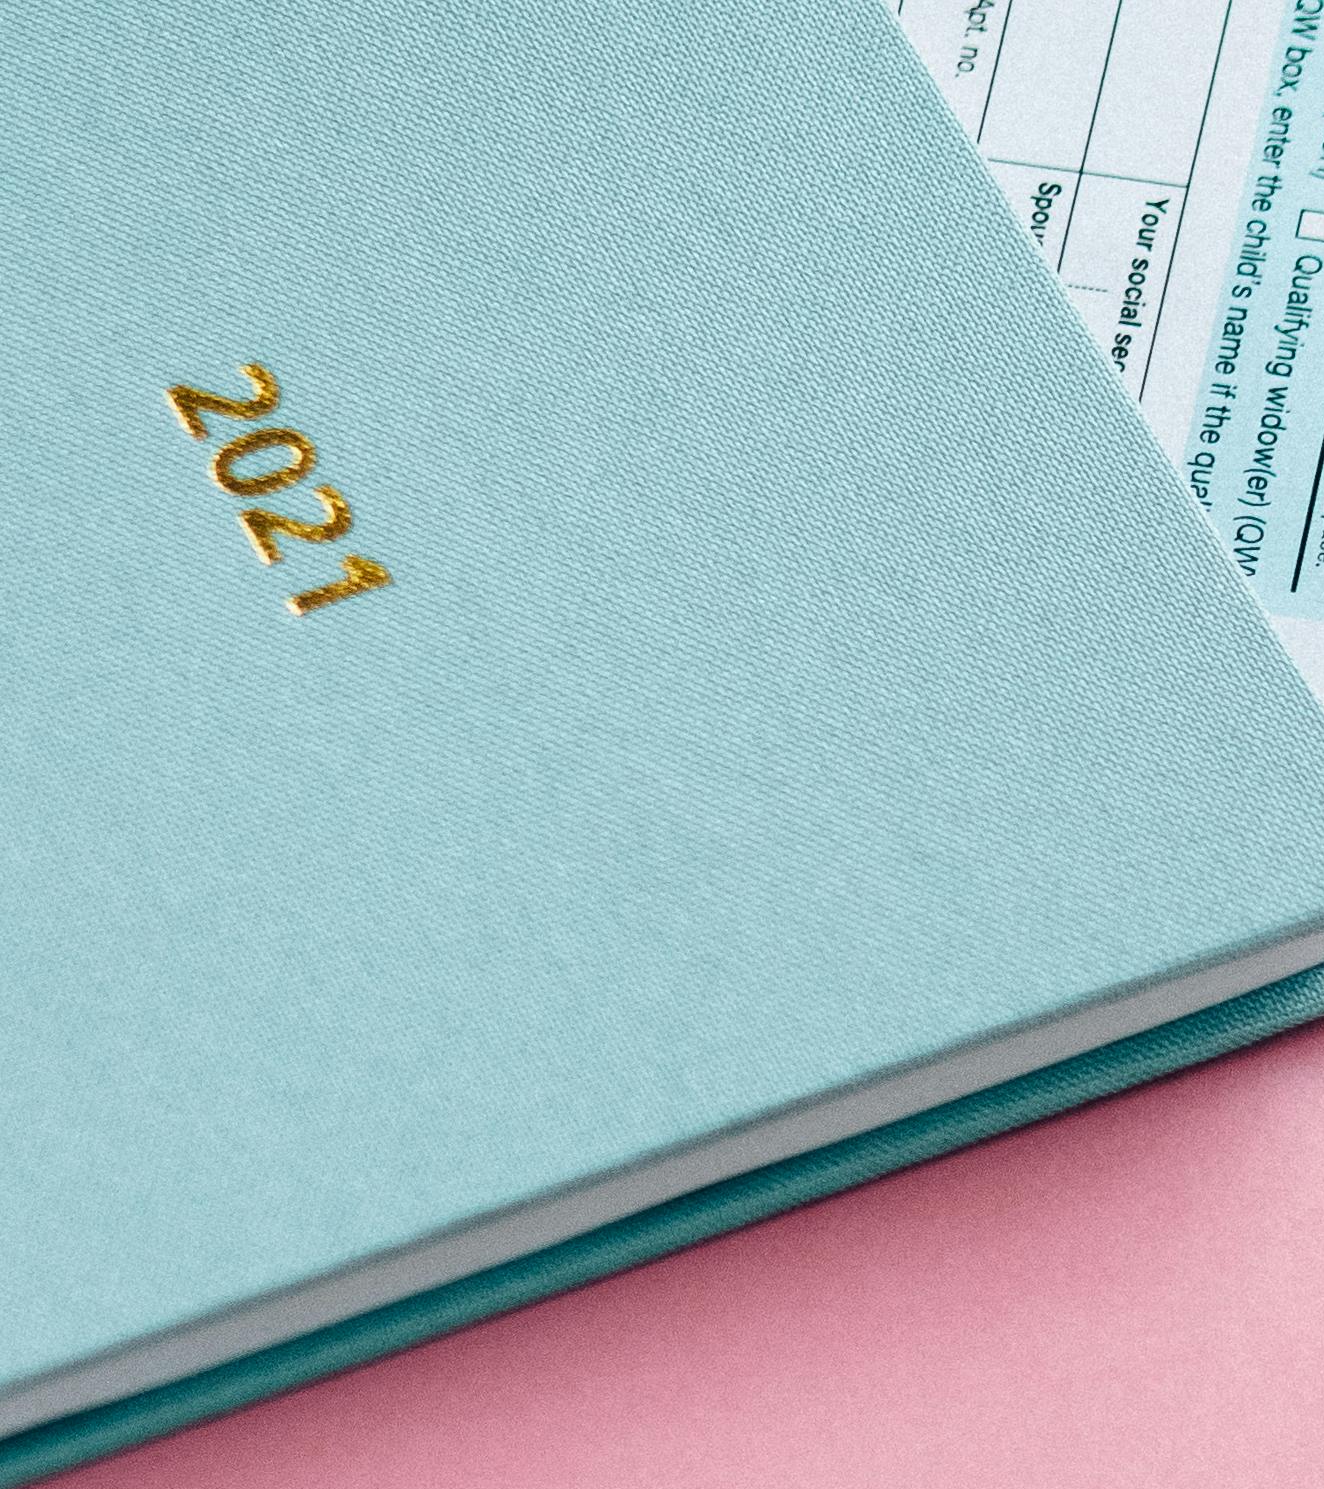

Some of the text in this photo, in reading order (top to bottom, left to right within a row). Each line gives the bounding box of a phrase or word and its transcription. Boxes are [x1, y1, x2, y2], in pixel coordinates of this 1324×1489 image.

[954, 0, 995, 78] Apt. no.
[1291, 0, 1323, 41] QW
[1272, 46, 1314, 97] box,
[1262, 105, 1293, 169] enter
[1030, 182, 1063, 247] Spou
[1136, 199, 1170, 252] Your
[1251, 175, 1283, 212] the
[1118, 258, 1150, 328] social
[1265, 254, 1324, 378] Qualifying
[1214, 306, 1249, 376] name
[1210, 381, 1239, 399] if
[1199, 404, 1232, 445] the
[1237, 385, 1289, 507] widow(er)
[164, 362, 395, 617] 2021
